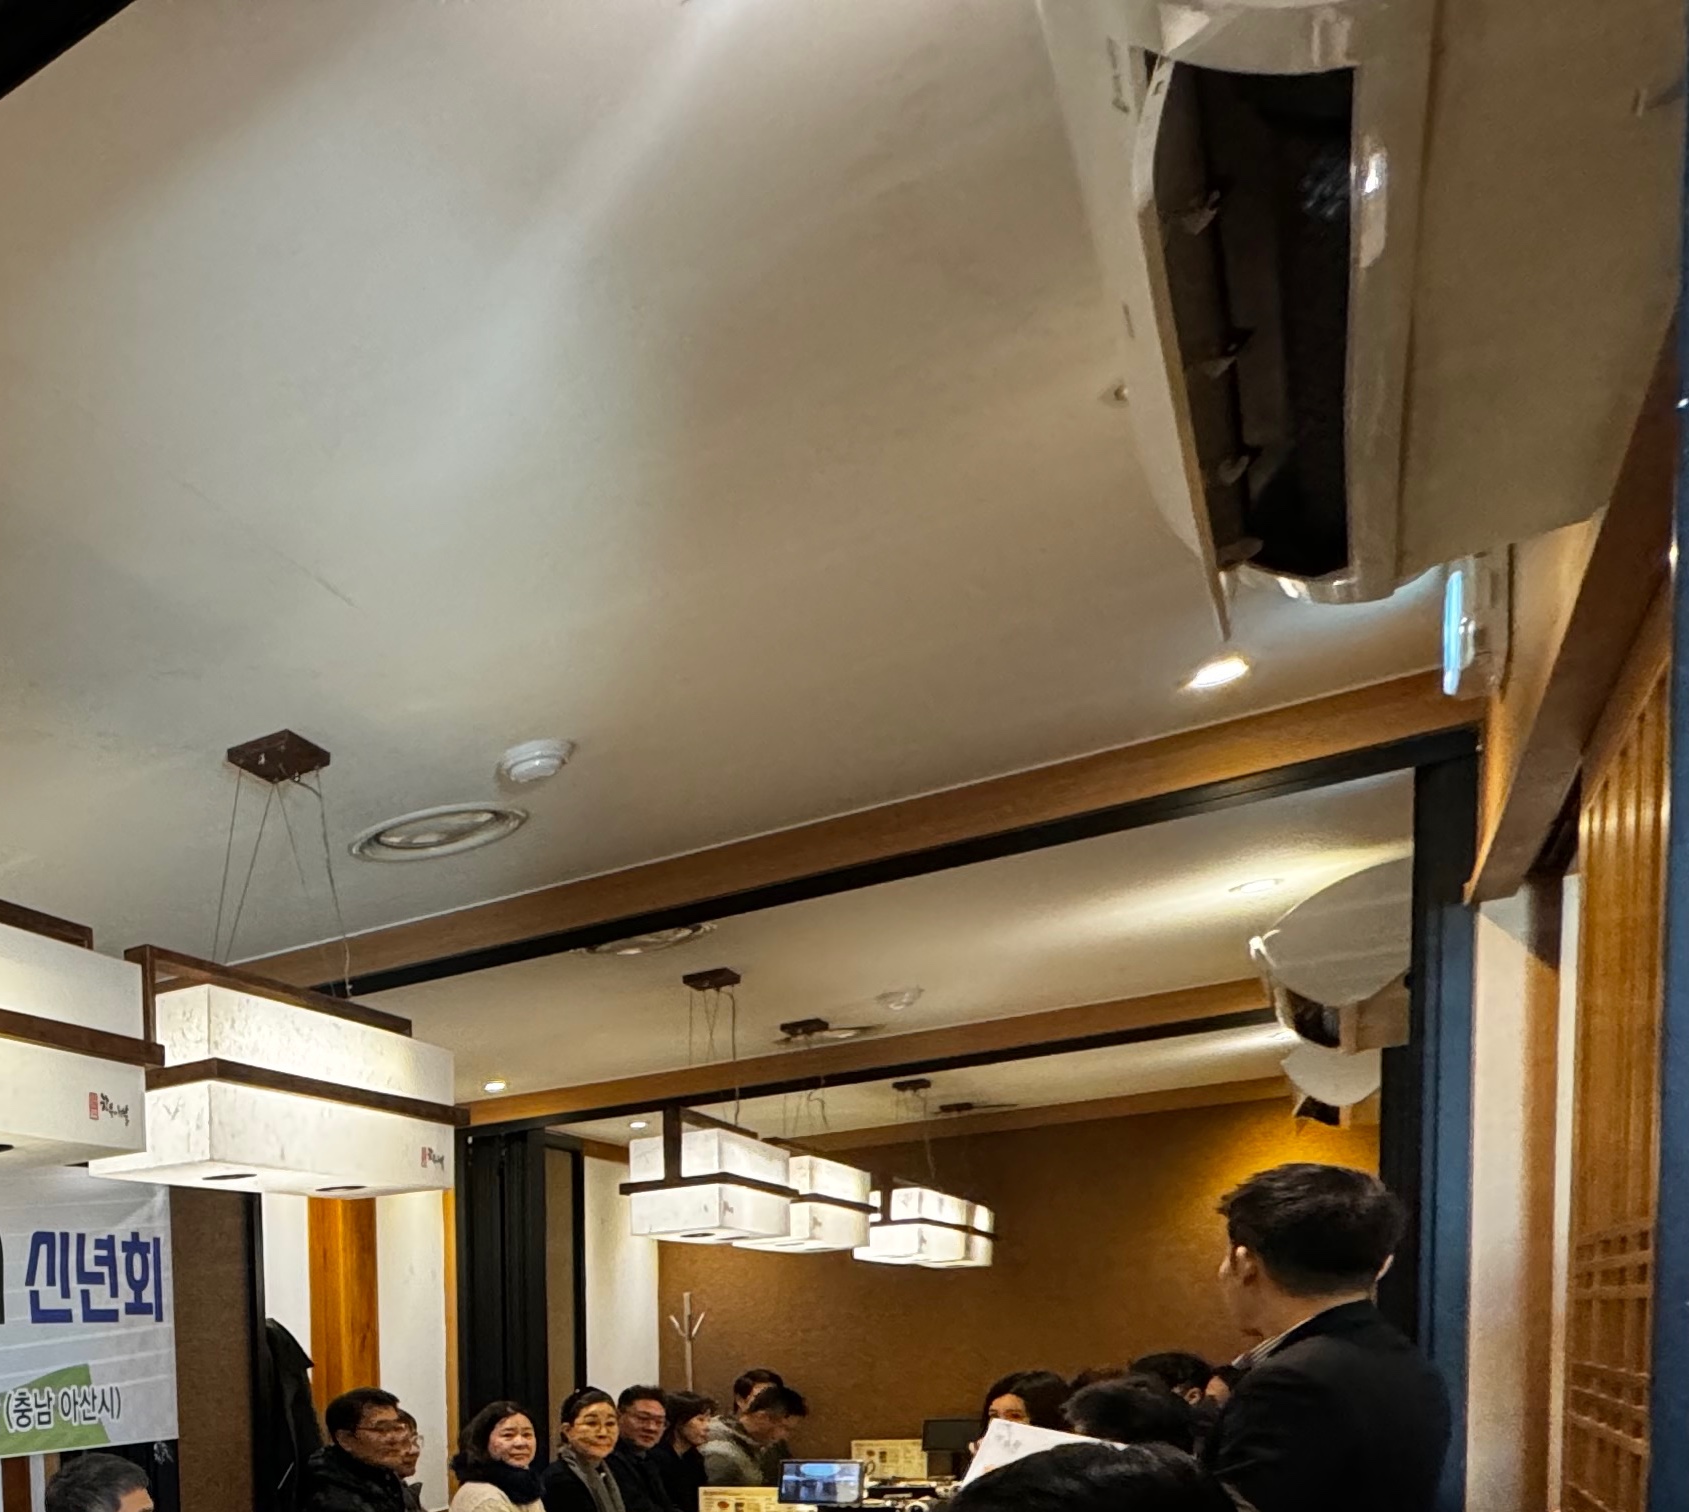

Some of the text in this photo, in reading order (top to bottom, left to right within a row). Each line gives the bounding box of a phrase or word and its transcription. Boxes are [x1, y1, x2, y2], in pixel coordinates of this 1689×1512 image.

[25, 1231, 163, 1323] 신년회
[5, 1389, 53, 1429] (충남
[60, 1385, 122, 1424] 아산시)
